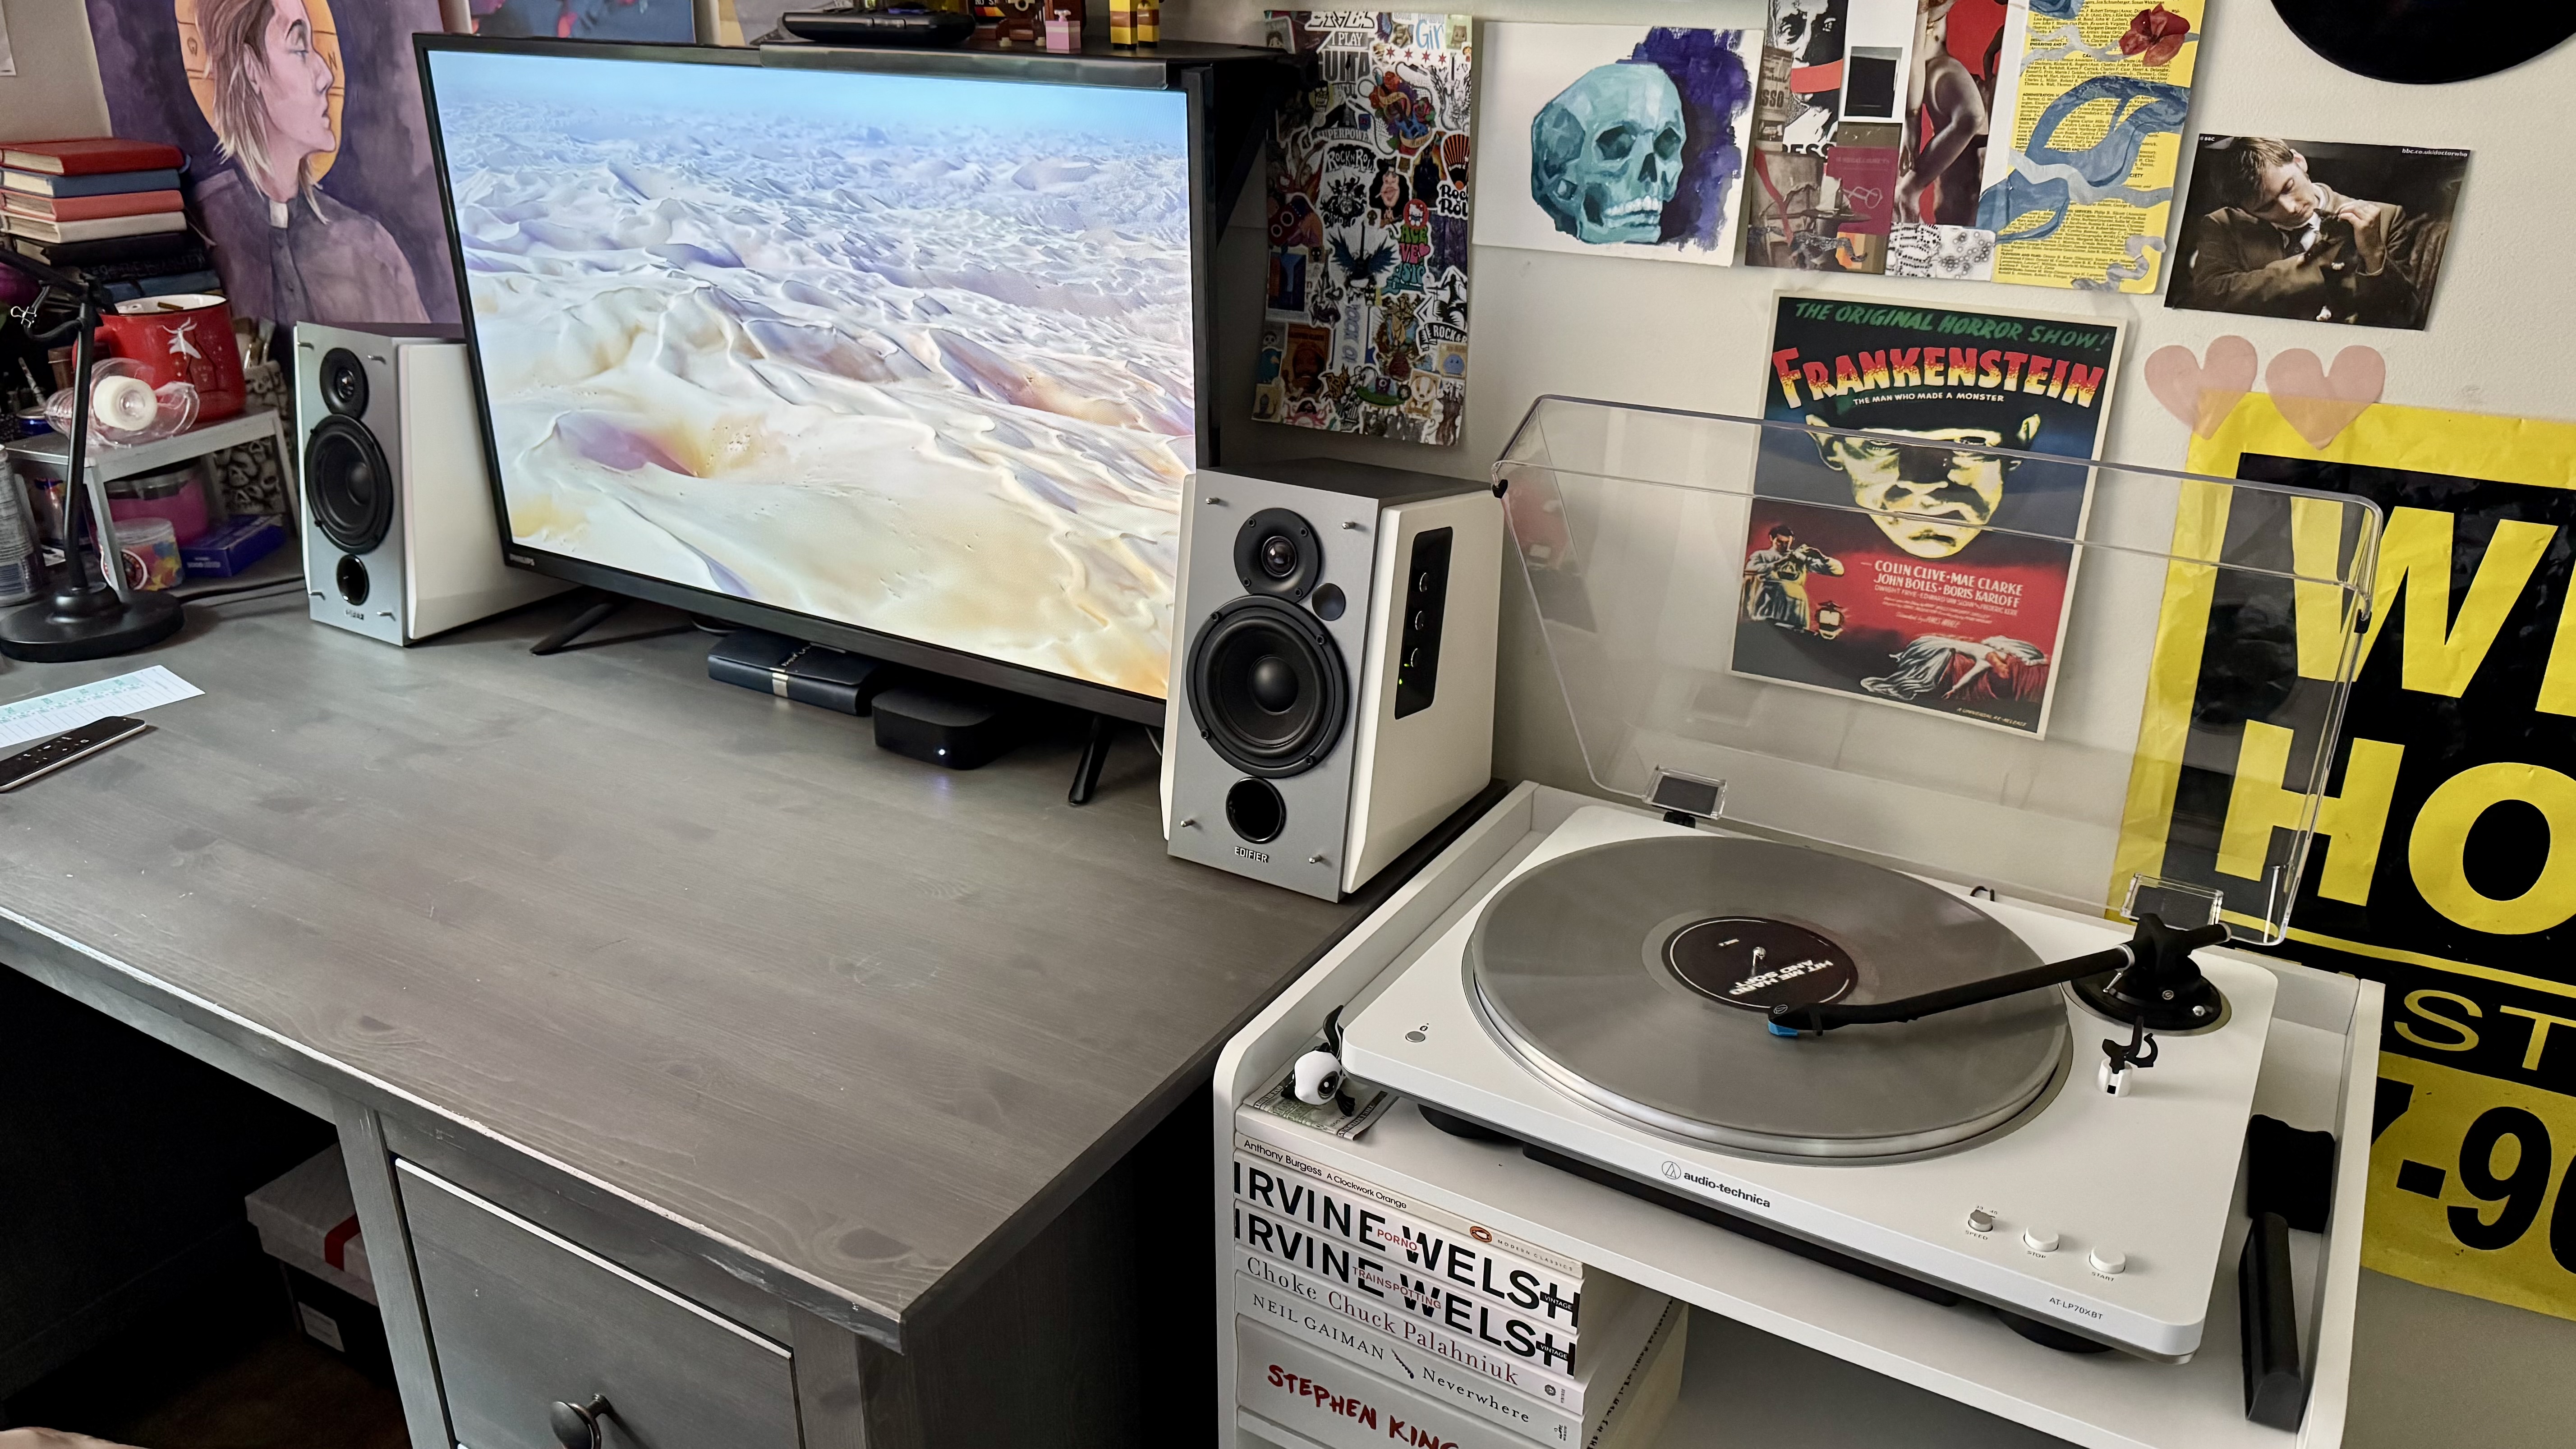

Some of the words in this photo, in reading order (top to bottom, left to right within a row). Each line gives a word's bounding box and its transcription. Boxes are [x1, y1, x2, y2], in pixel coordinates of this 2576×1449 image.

[1338, 32, 1363, 46] PLAY
[2401, 147, 2468, 157] bbc.co.uk/doctorwho
[1398, 224, 1428, 244] ACE
[1399, 243, 1420, 265] VE
[1795, 301, 1837, 321] THE
[1835, 304, 1933, 332] ORIGINAL
[1937, 314, 2024, 341] HORROR
[2027, 326, 2111, 352] SHOW!
[1771, 346, 2105, 409] FRANKENSTEIN
[1853, 396, 1871, 405] THE
[1872, 395, 1893, 405] MAN
[1895, 393, 1916, 401] WHO
[1917, 392, 1943, 400] MADE
[1956, 392, 2005, 403] MONSTER
[1873, 573, 1904, 587] JOHN
[1904, 578, 1938, 593] BOLES
[1943, 584, 1973, 600] BORIS
[1975, 590, 2021, 608] KARLOFF
[1874, 560, 1912, 576] COLIN
[1913, 566, 1946, 583] CLIVE
[1950, 572, 1976, 587] MAE
[1978, 578, 2024, 597] CLARKE
[1234, 846, 1270, 864] EDIFIER
[1244, 1139, 1283, 1160] Anthony
[1285, 1154, 1323, 1177] Burgess
[1326, 1172, 1334, 1181] A
[1335, 1173, 1375, 1199] Clockwork
[1375, 1190, 1408, 1210] Orange
[1684, 1172, 1771, 1208] audio-technica
[1234, 1160, 1386, 1252] IRVINE
[1402, 1225, 1581, 1327] WELSH
[1376, 1228, 1418, 1252] PORNO
[2027, 1250, 2047, 1260] STOP
[1234, 1207, 1385, 1299] IRVINE
[1399, 1273, 1578, 1377] WELSH
[1352, 1266, 1442, 1310] TRAINSPOTTING
[2091, 1271, 2115, 1283] START
[1544, 1294, 1572, 1311] VINTAGE
[2049, 1296, 2104, 1321] AT-LP70XBT
[1247, 1256, 1319, 1302] Choke
[1328, 1291, 1398, 1334] Chuck
[1403, 1321, 1520, 1387] Palahniuk
[1252, 1293, 1298, 1324] NEIL
[1303, 1316, 1385, 1361] GAIMAN
[1422, 1365, 1530, 1424] Neverwhere
[1540, 1344, 1568, 1360] VINTAGE
[1267, 1364, 1377, 1431] STEPHEN
